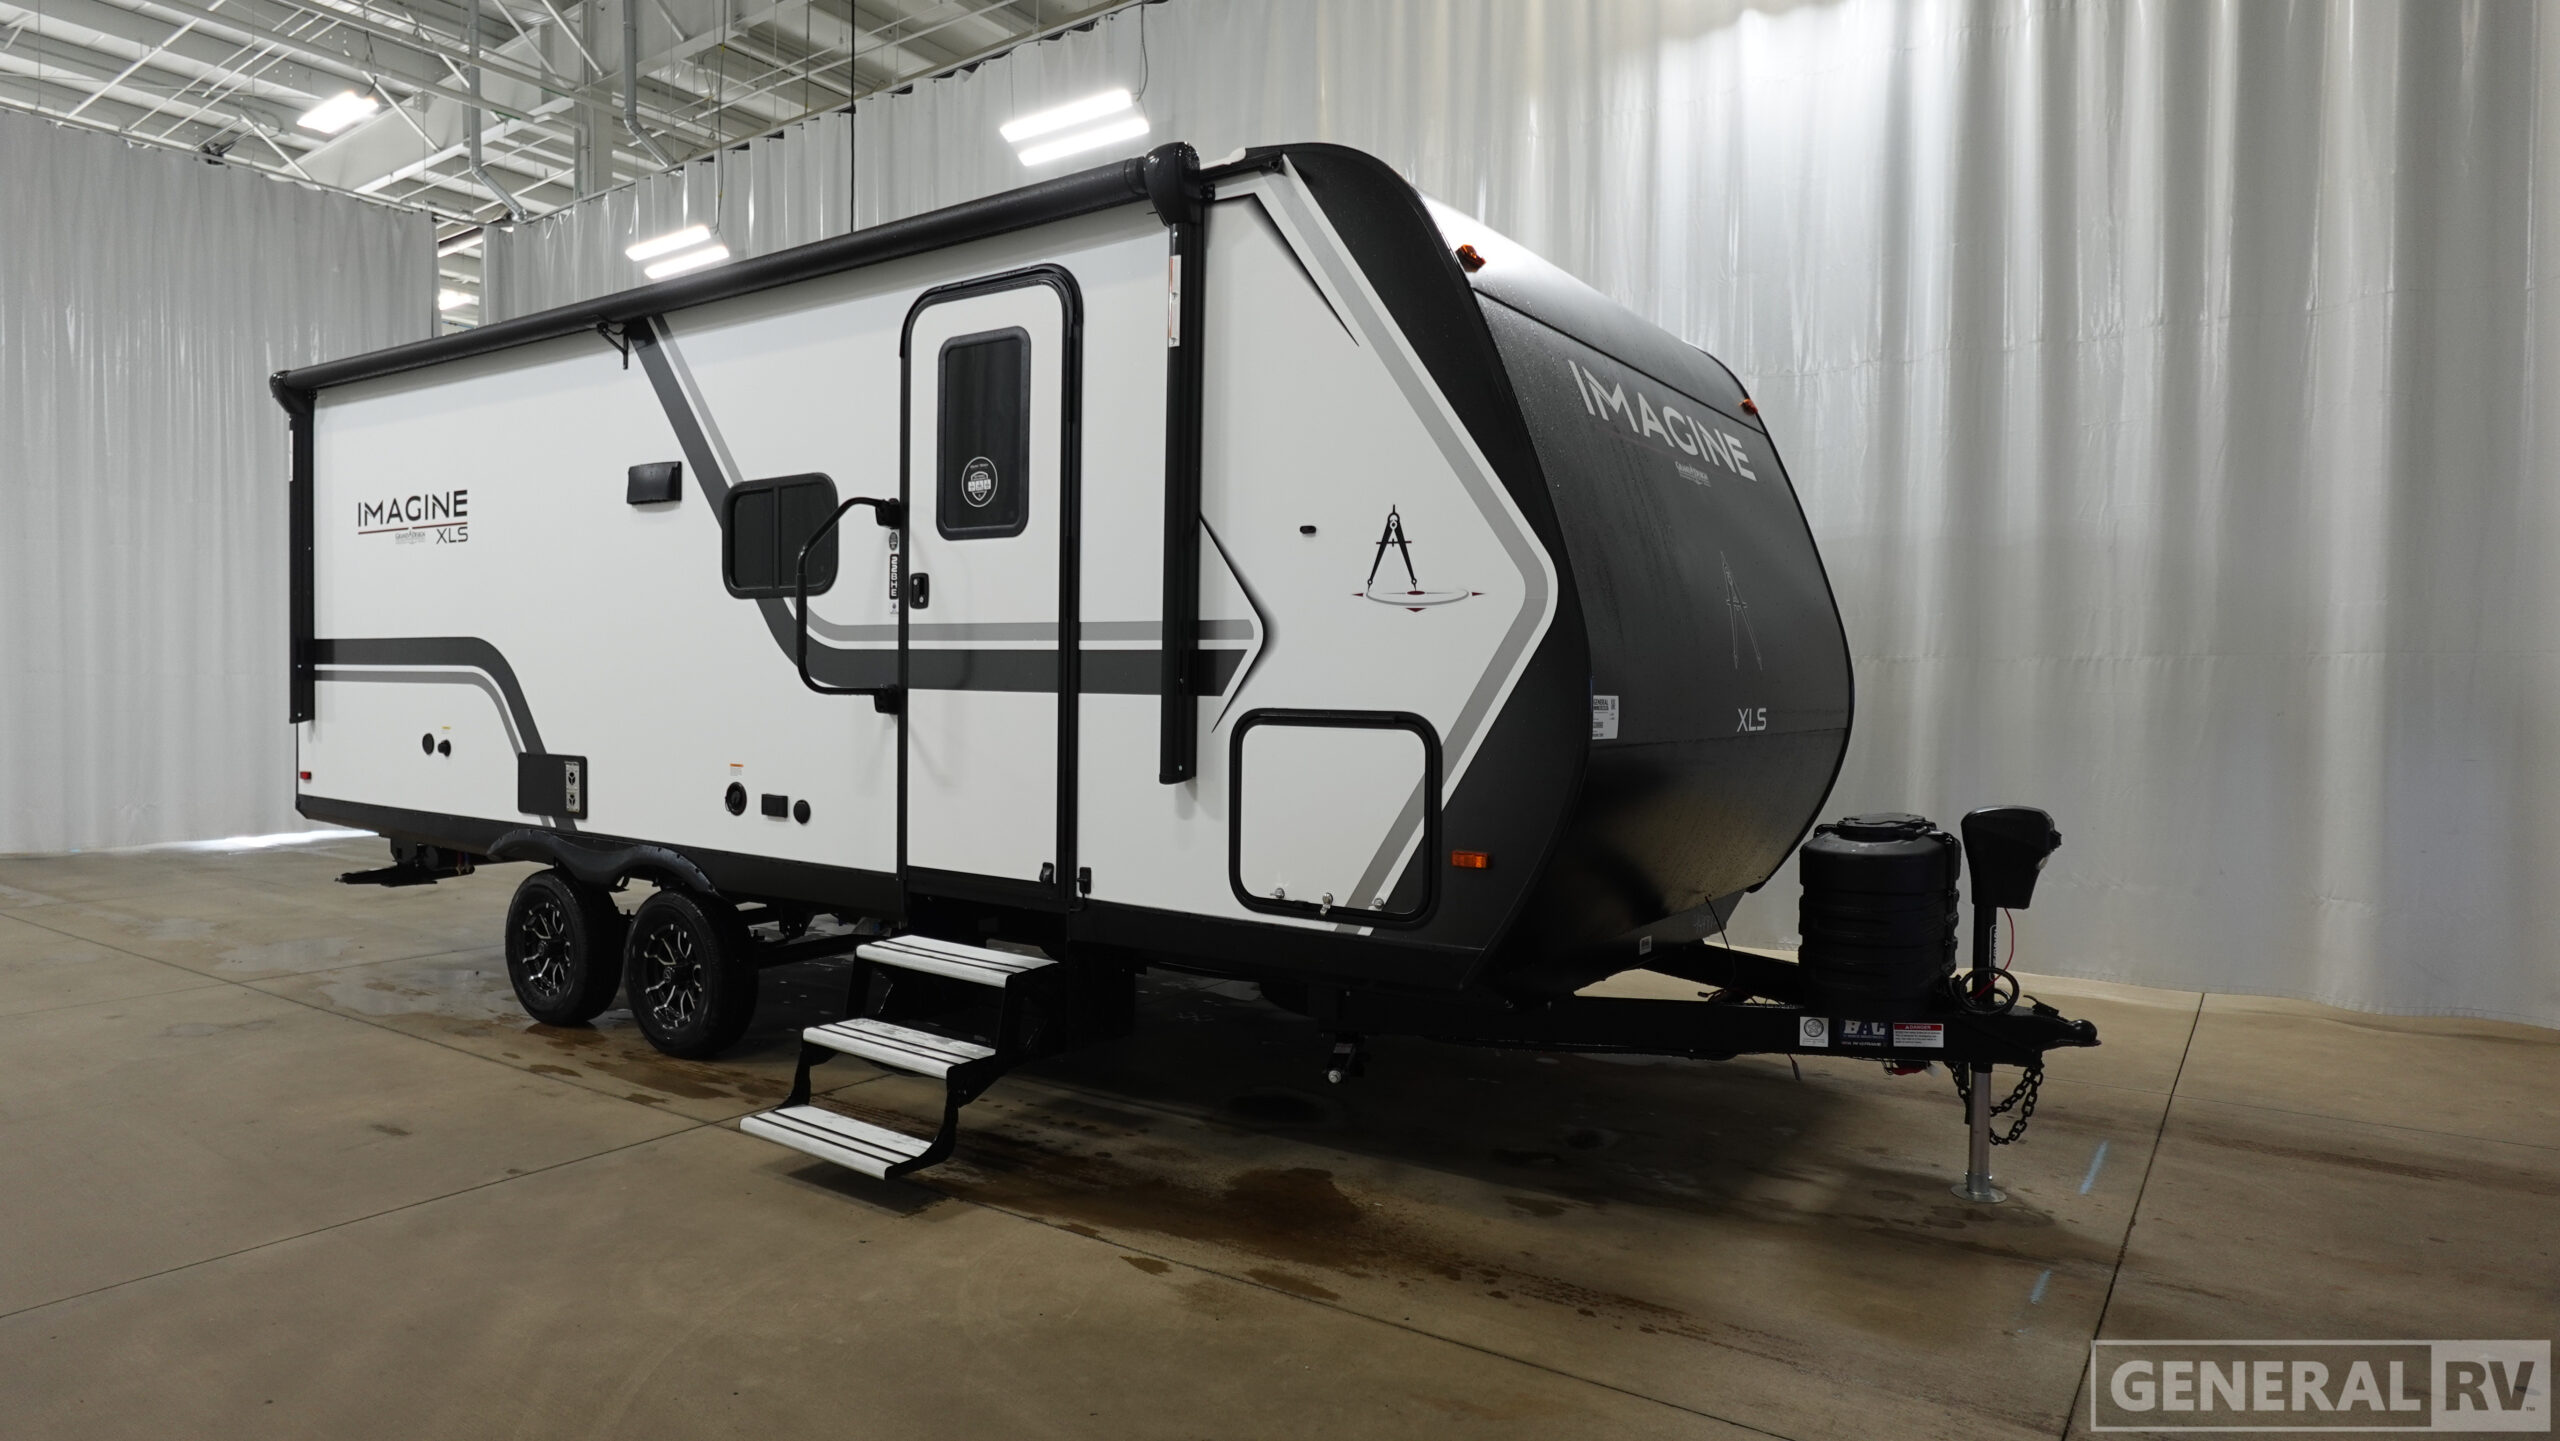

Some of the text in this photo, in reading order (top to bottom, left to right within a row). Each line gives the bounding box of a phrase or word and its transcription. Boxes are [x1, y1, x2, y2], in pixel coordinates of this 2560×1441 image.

[1568, 359, 1757, 482] IMAGINE
[358, 489, 468, 527] IMAGINE
[436, 526, 469, 544] XLS
[1736, 707, 1767, 732] XLS
